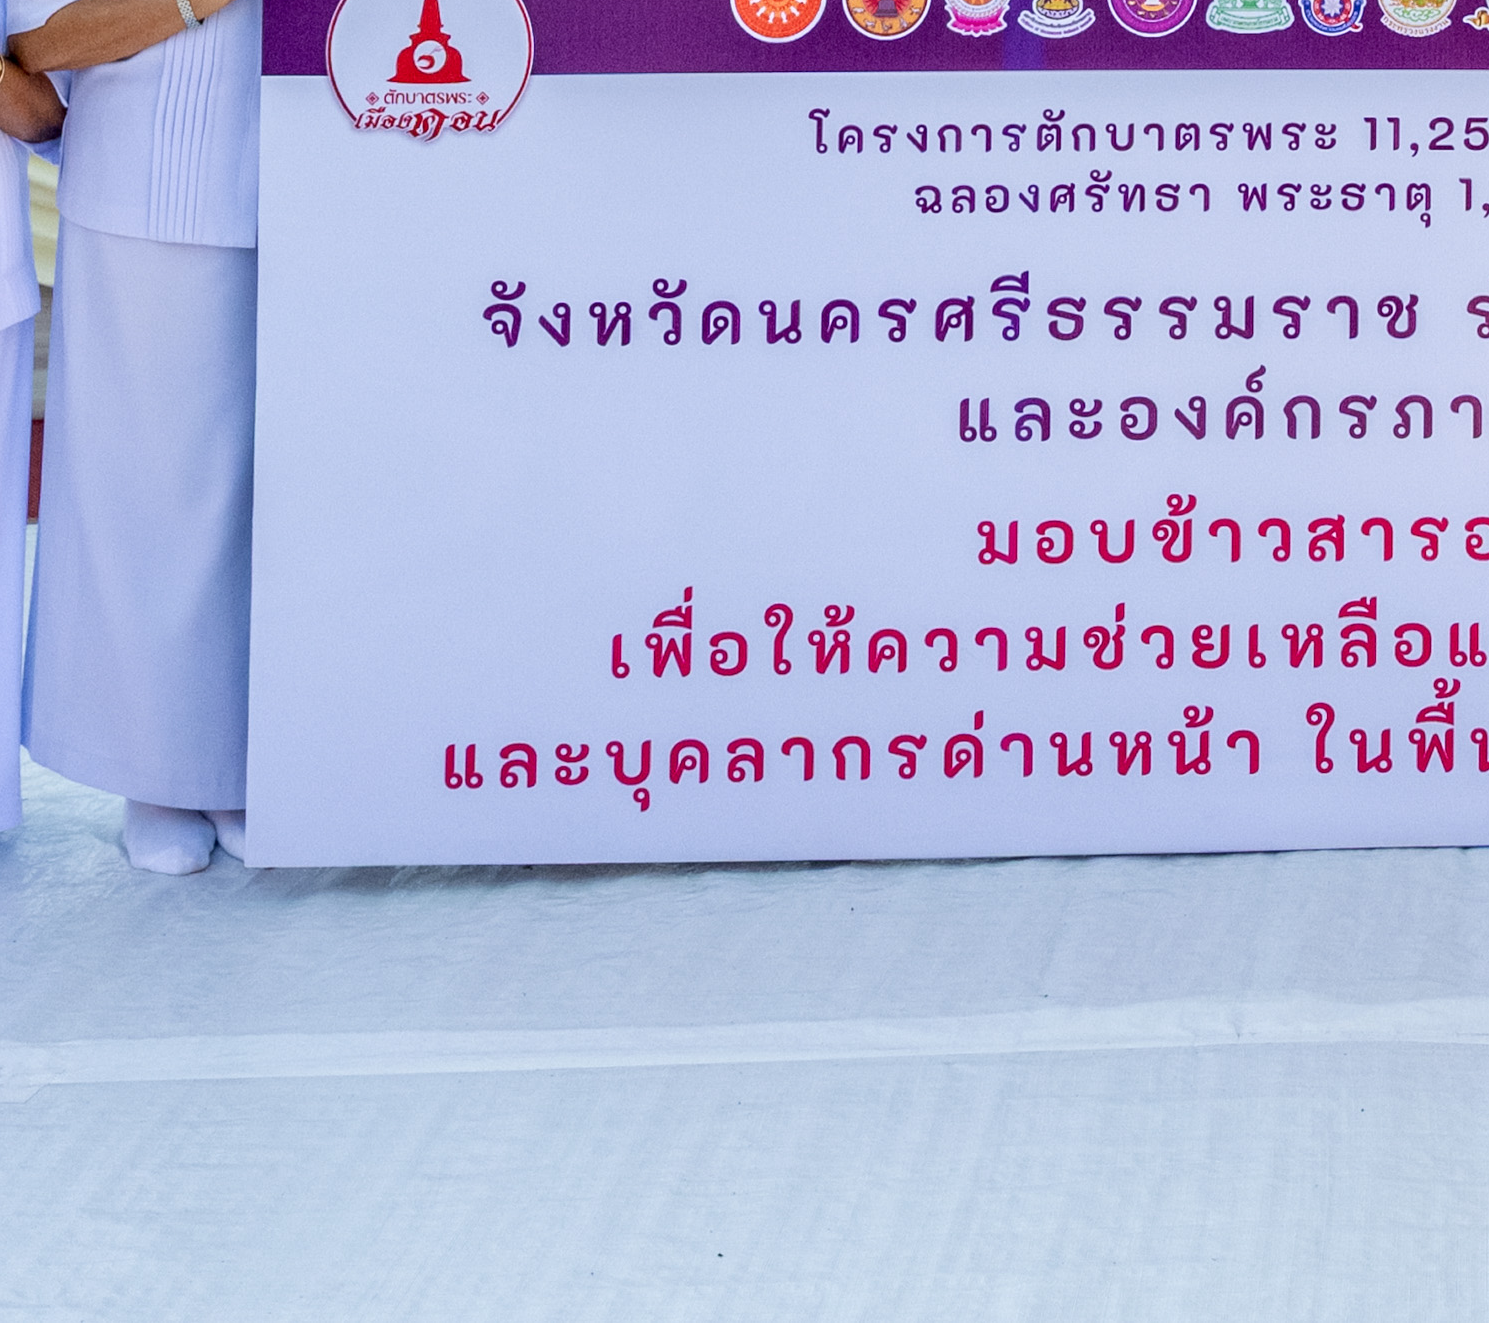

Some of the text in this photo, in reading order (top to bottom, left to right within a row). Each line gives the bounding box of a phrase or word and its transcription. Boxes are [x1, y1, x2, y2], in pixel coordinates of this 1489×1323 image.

[384, 88, 472, 104] ตักบาตรพระ
[808, 108, 1337, 155] โครงการตักบาตรพระ
[914, 168, 1211, 215] ฉลองศรัทธา
[1237, 176, 1432, 229] พระธาตุ
[482, 270, 1420, 349] จังหวัดนครศรีธรรมราช
[443, 708, 1260, 813] และบุคลากรด่านหน้า
